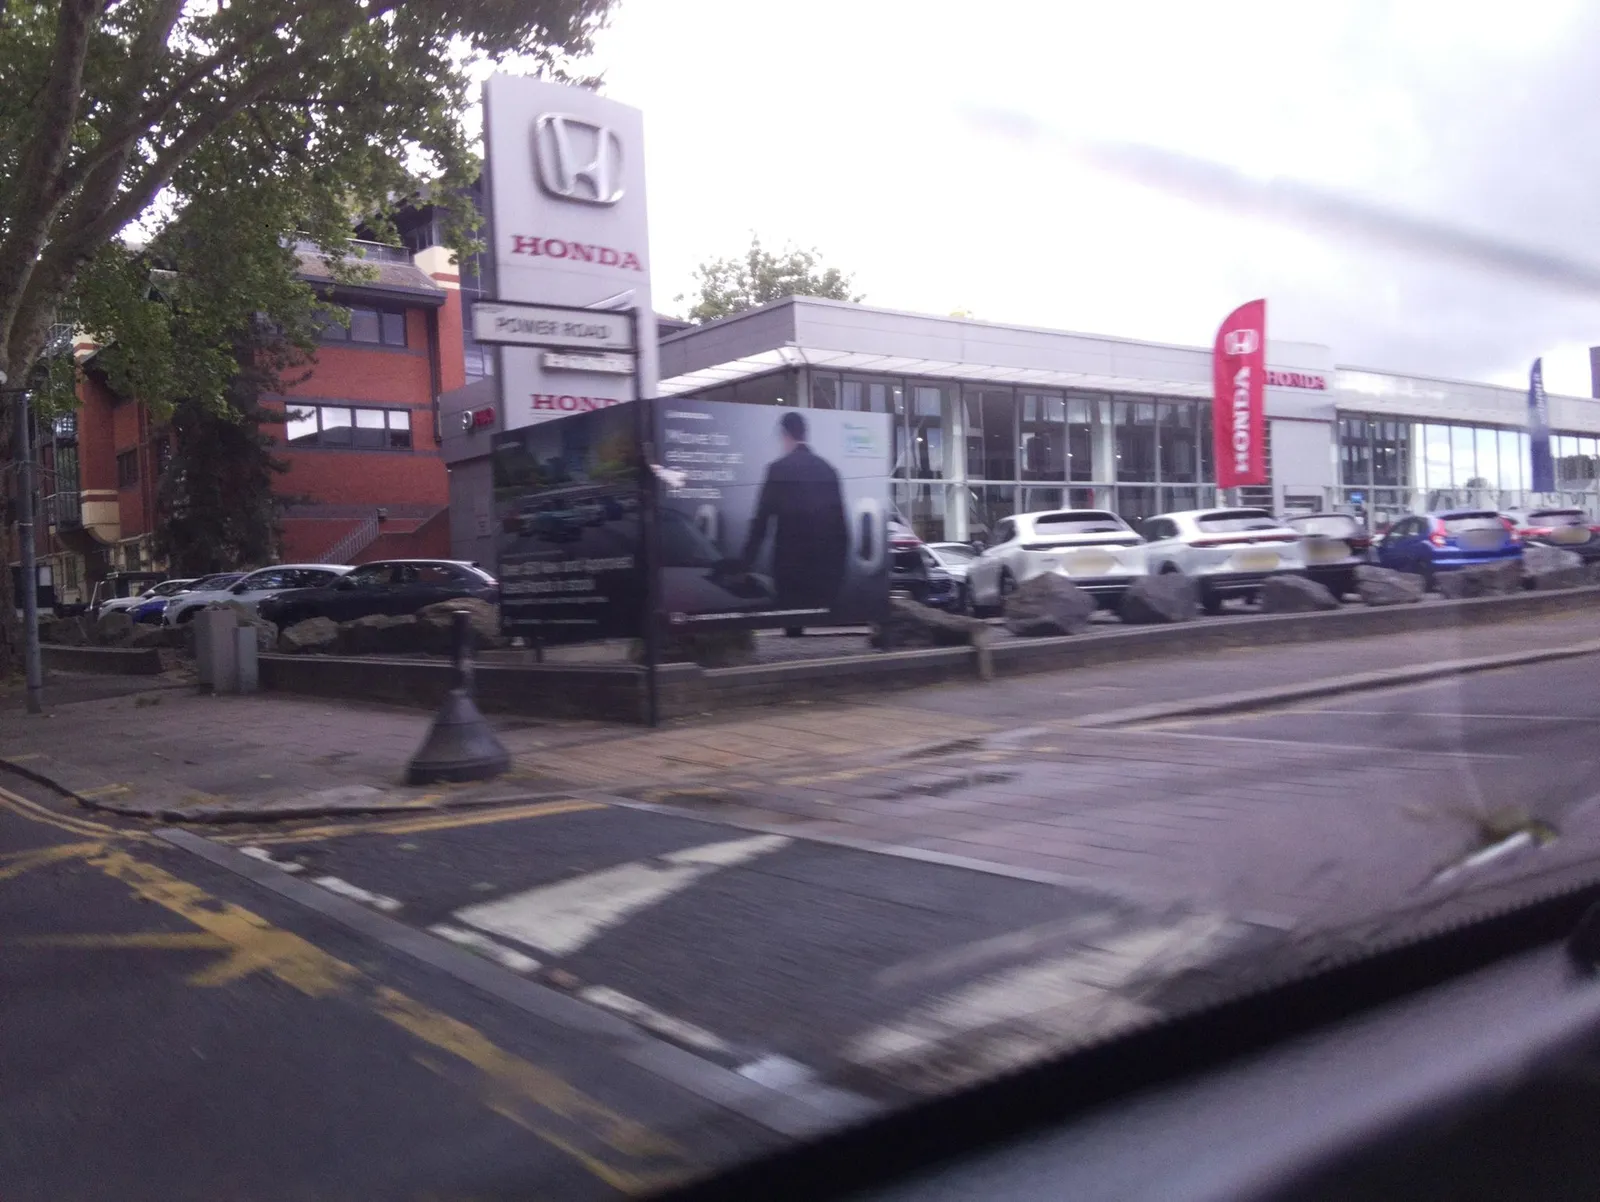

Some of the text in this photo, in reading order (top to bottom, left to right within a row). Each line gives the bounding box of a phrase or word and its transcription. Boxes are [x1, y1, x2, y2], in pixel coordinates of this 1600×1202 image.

[511, 235, 643, 271] HONDA
[496, 317, 611, 339] POWER ROAD
[1234, 366, 1250, 473] HONDA
